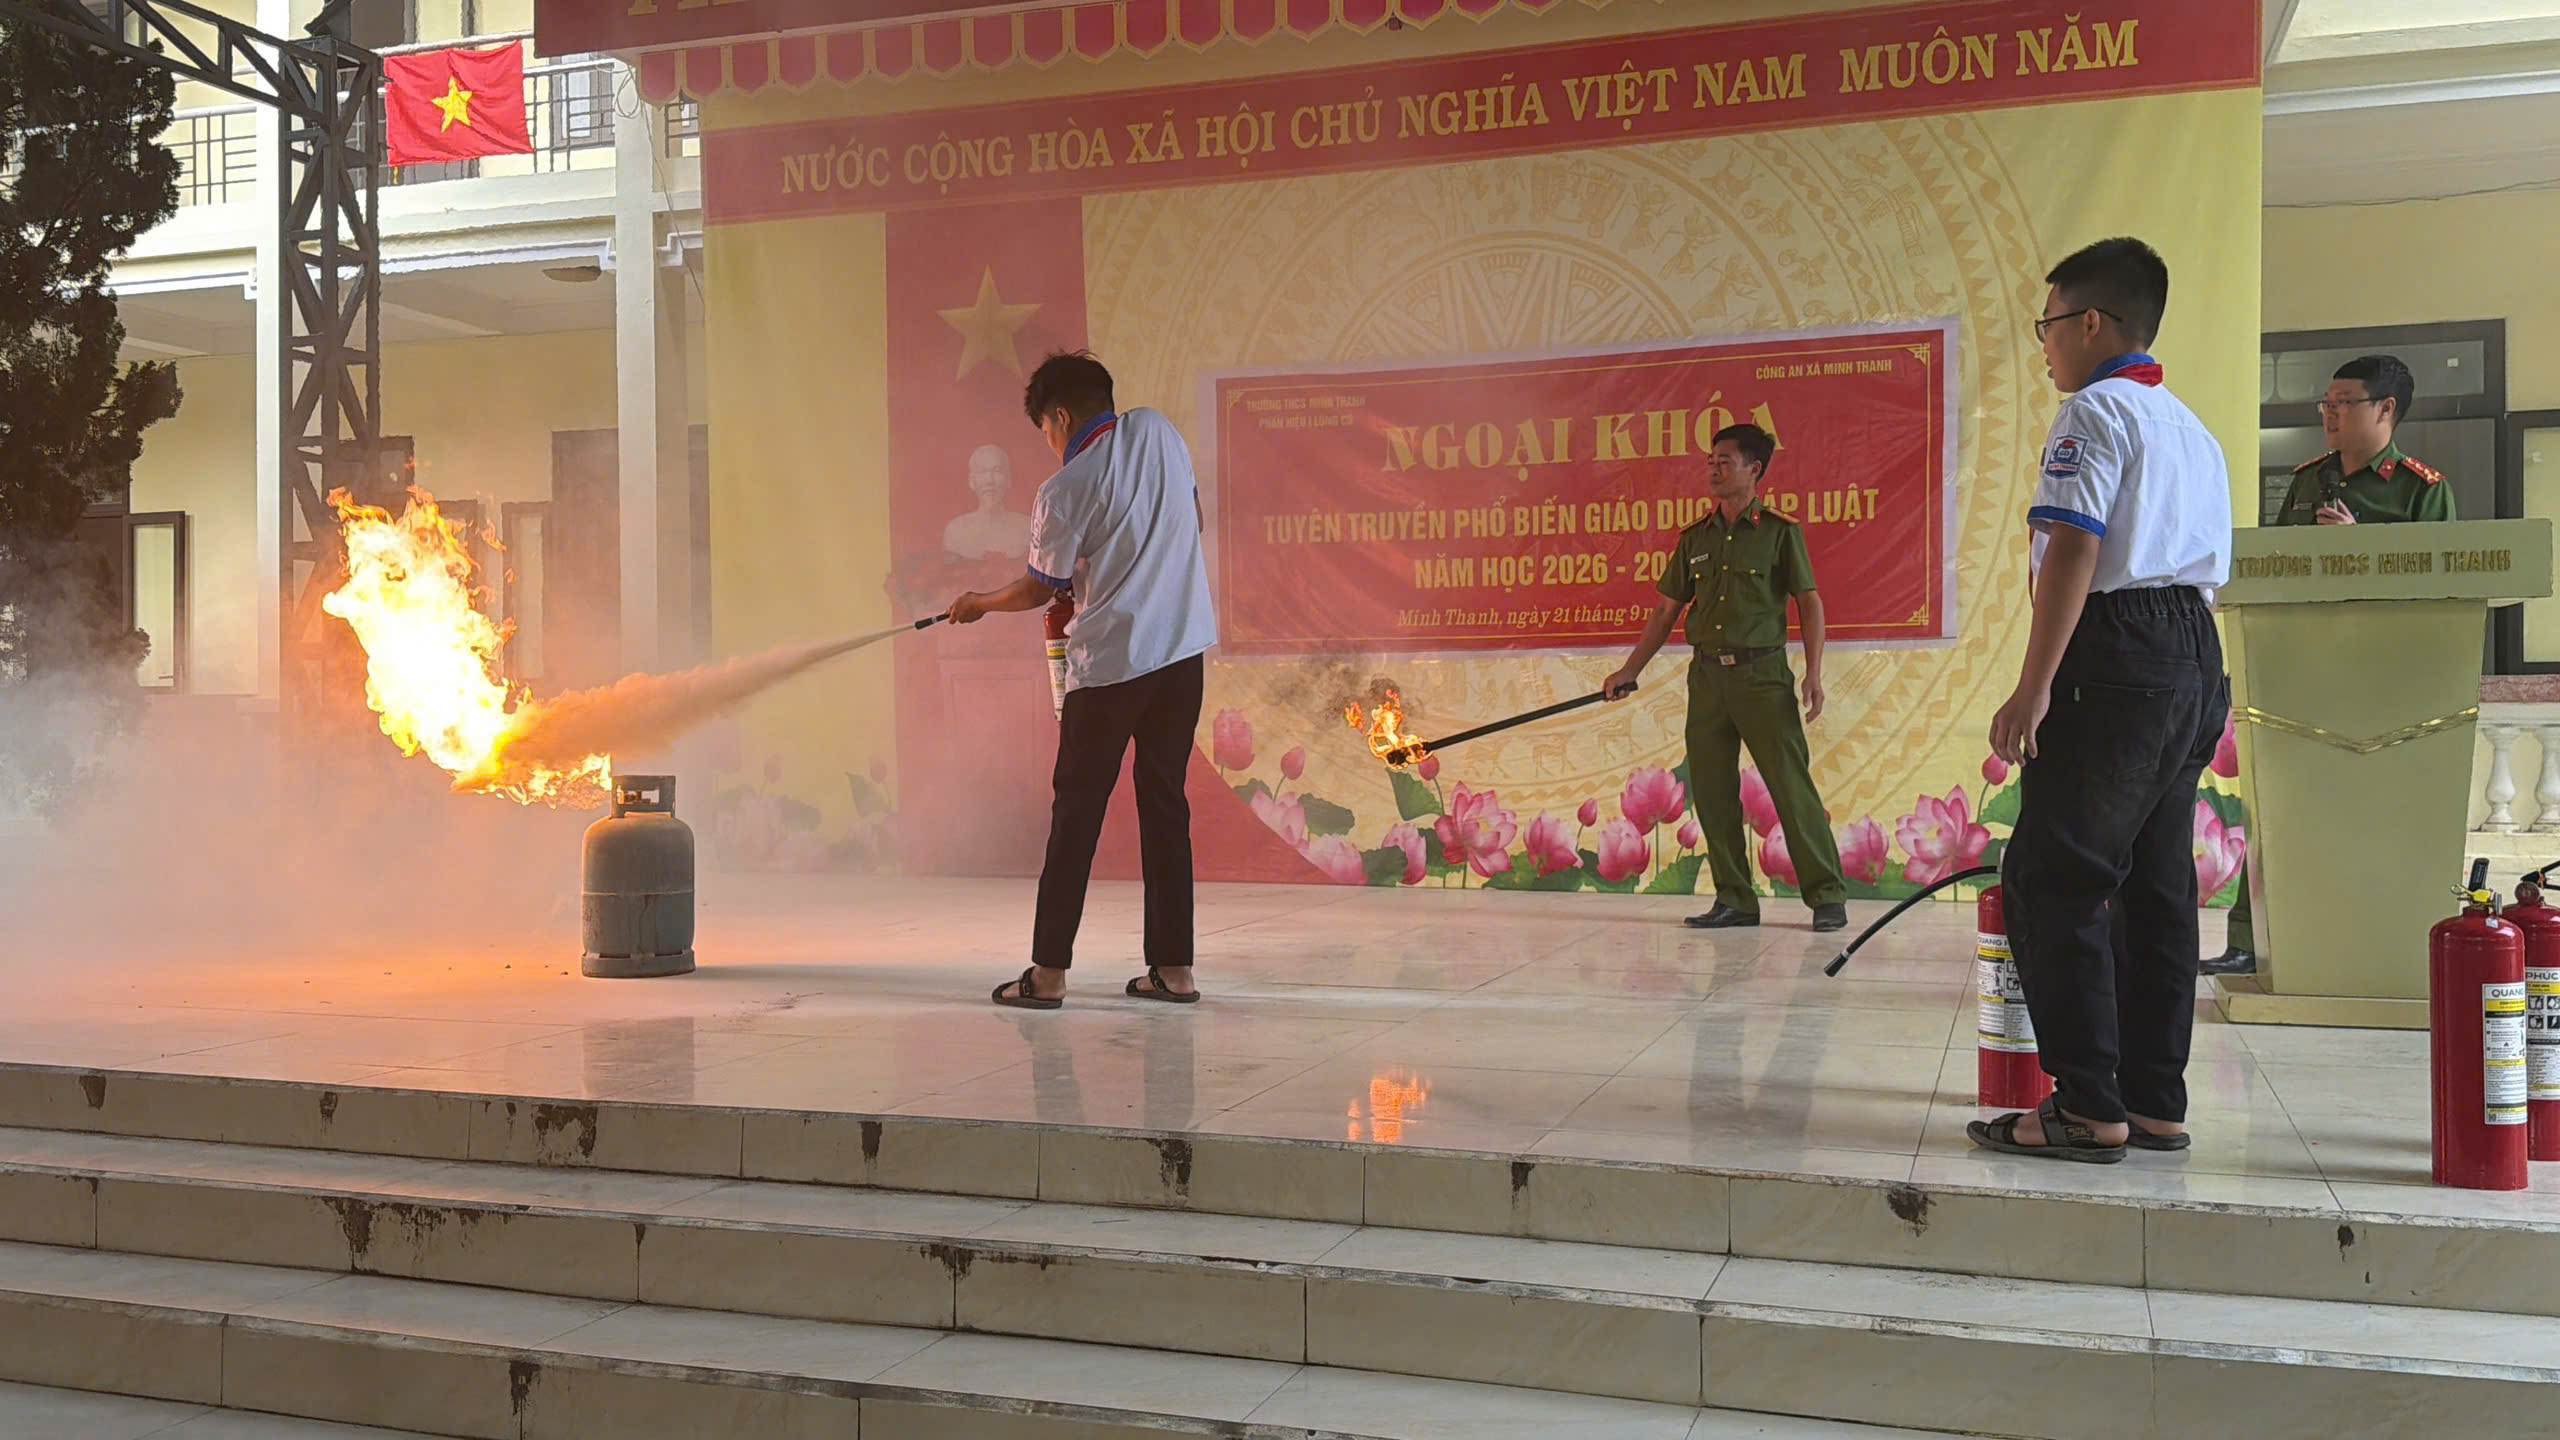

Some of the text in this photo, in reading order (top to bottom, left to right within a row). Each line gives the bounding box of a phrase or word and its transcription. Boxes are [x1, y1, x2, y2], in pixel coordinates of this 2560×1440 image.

[782, 11, 2140, 195] NƯỚC CỘNG HÒA XÃ HỘI CHỦ NGHĨA VIỆT NAM MUÔN NĂM
[1755, 364, 1786, 380] CÔNG
[1788, 364, 1803, 378] AN
[1823, 361, 1853, 375] MINH
[1855, 358, 1893, 374] THANH
[1380, 416, 1574, 483] NGOẠI
[1263, 508, 1342, 544] TUYÊN
[1347, 501, 1447, 541] TRUYỀN
[1453, 495, 1507, 539] PHỔ
[1513, 494, 1577, 537] BIẾN
[1584, 491, 1650, 534] GIÁO
[1806, 482, 1880, 529] LUẬT
[1414, 553, 1475, 589] NĂM
[1481, 554, 1535, 593] HỌC
[1542, 552, 1609, 586] 2026
[2318, 552, 2370, 577] THCS
[1398, 609, 1442, 627] Minh
[1506, 604, 1551, 629] ngày
[1553, 607, 1572, 624] 21
[1573, 603, 1628, 627] tháng
[1629, 606, 1640, 623] 9
